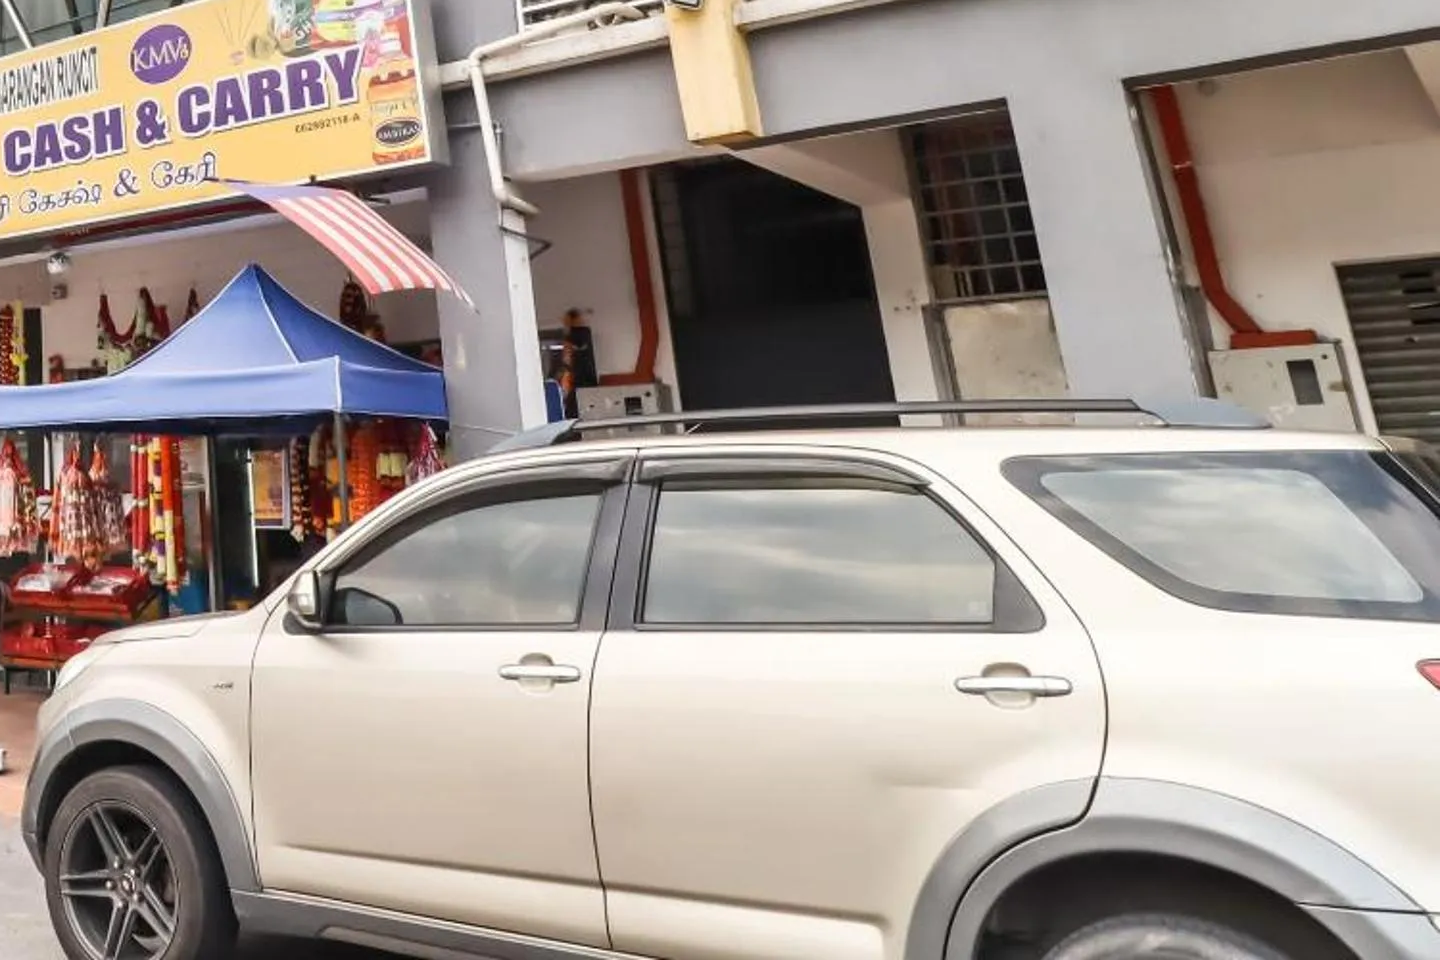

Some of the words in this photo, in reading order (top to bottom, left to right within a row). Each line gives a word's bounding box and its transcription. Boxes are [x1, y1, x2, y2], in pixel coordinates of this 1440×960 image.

[3, 106, 124, 174] CASH
[135, 99, 167, 145] &
[177, 47, 361, 135] CARRY
[114, 168, 141, 198] &
